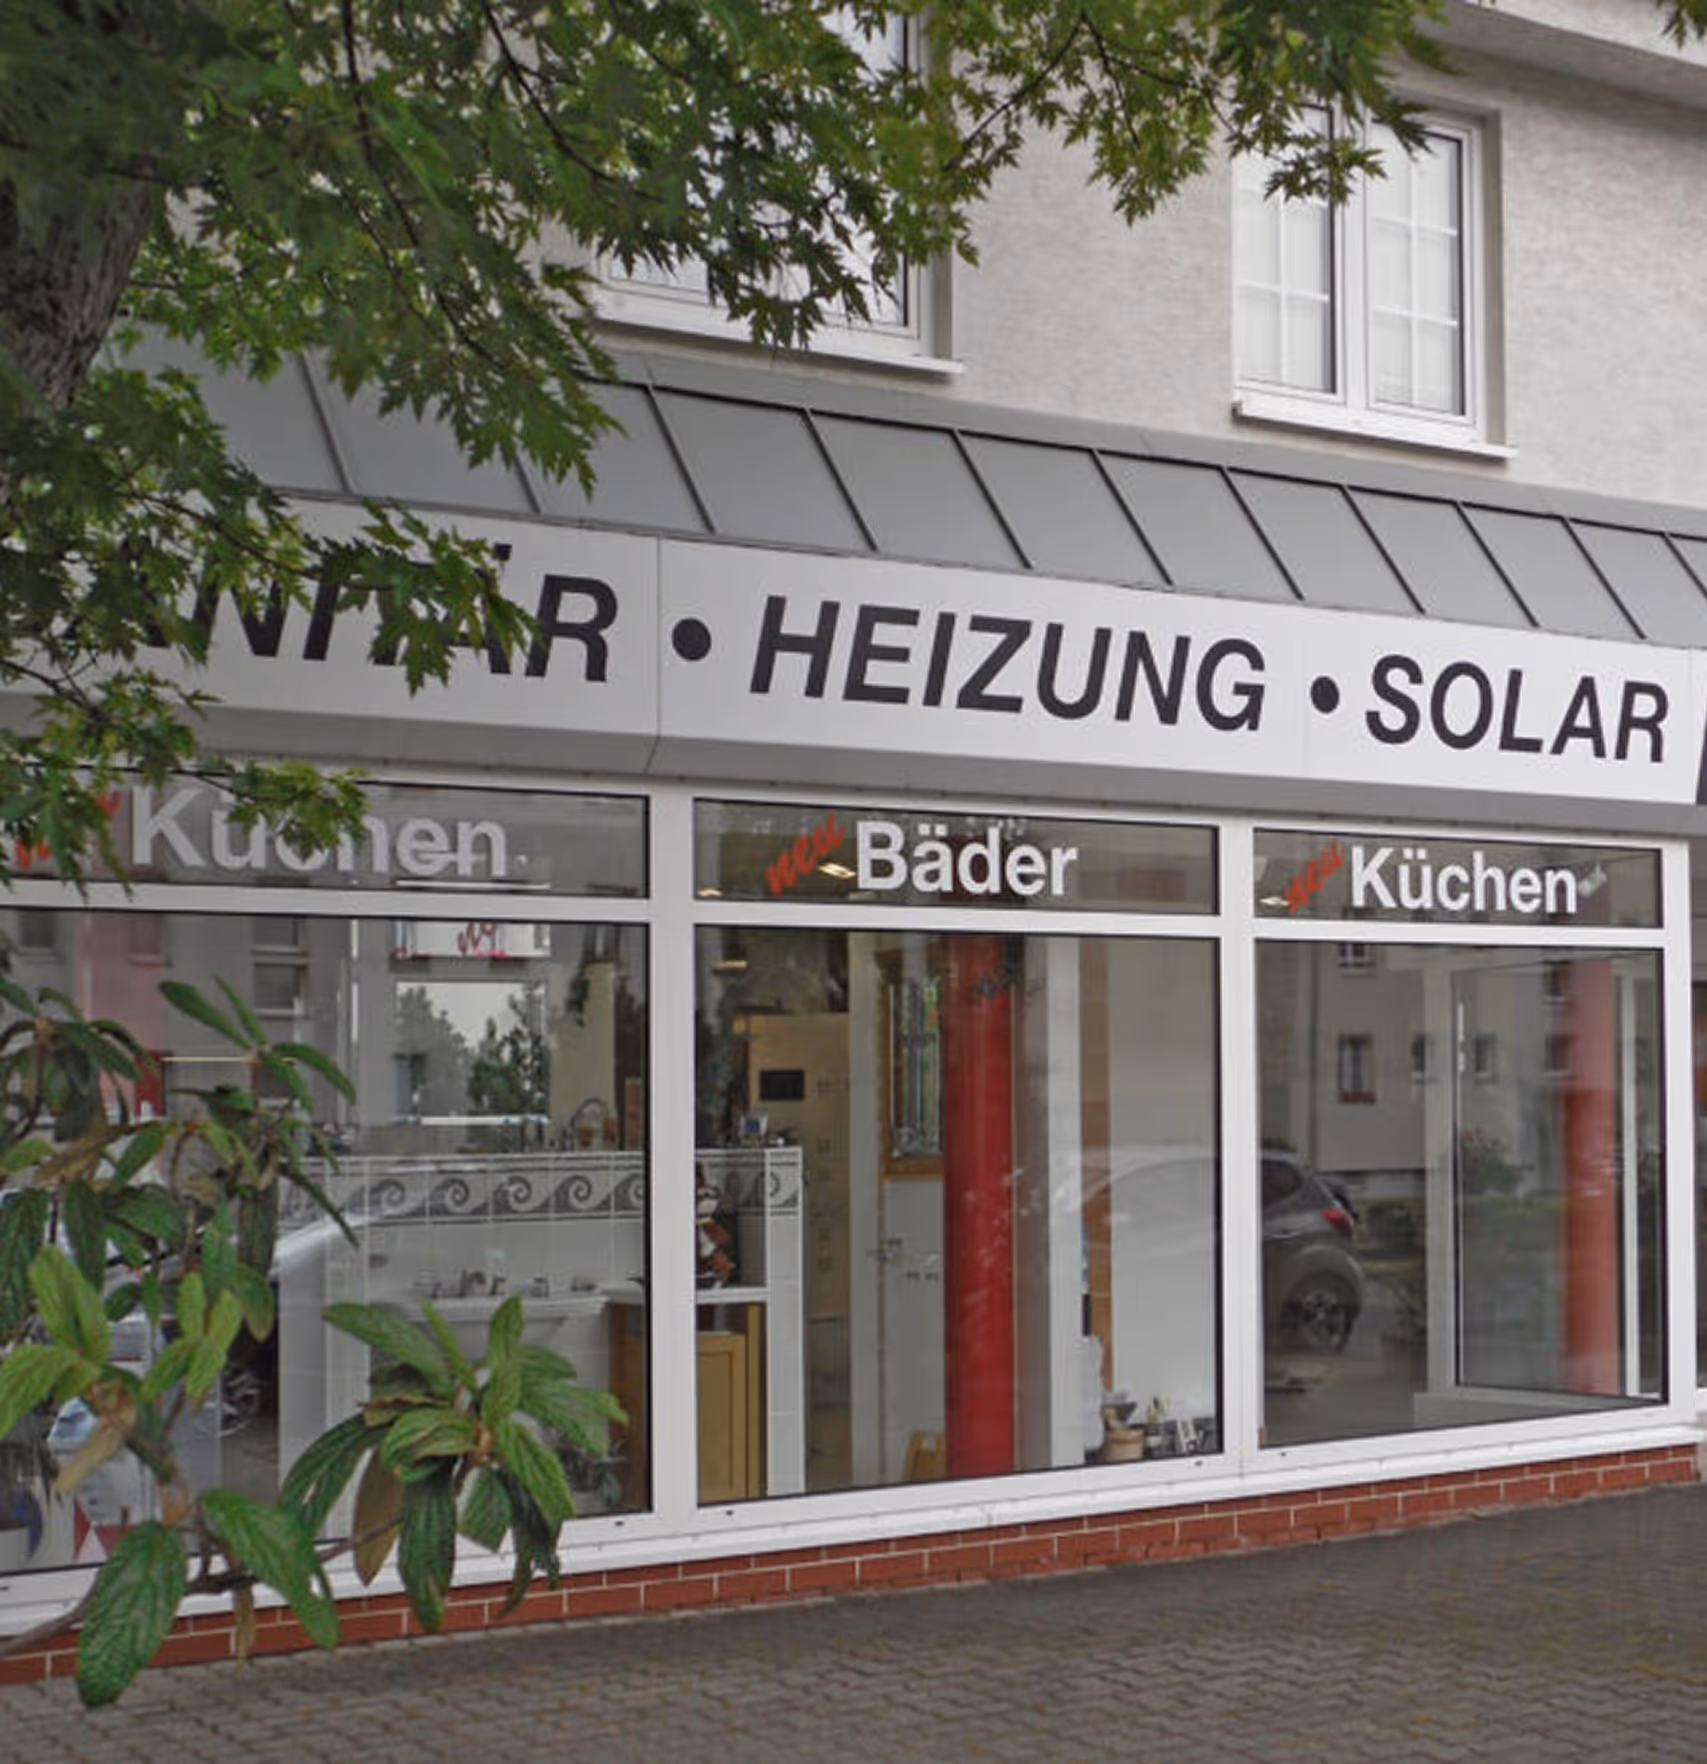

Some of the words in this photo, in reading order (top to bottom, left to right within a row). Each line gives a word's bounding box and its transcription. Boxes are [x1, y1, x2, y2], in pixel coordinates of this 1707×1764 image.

[749, 596, 1266, 731] HEIZUNG
[1365, 655, 1669, 763] SOLAR
[764, 813, 847, 895] neu
[856, 820, 1078, 898] Bäder
[1350, 846, 1578, 914] Küchen
